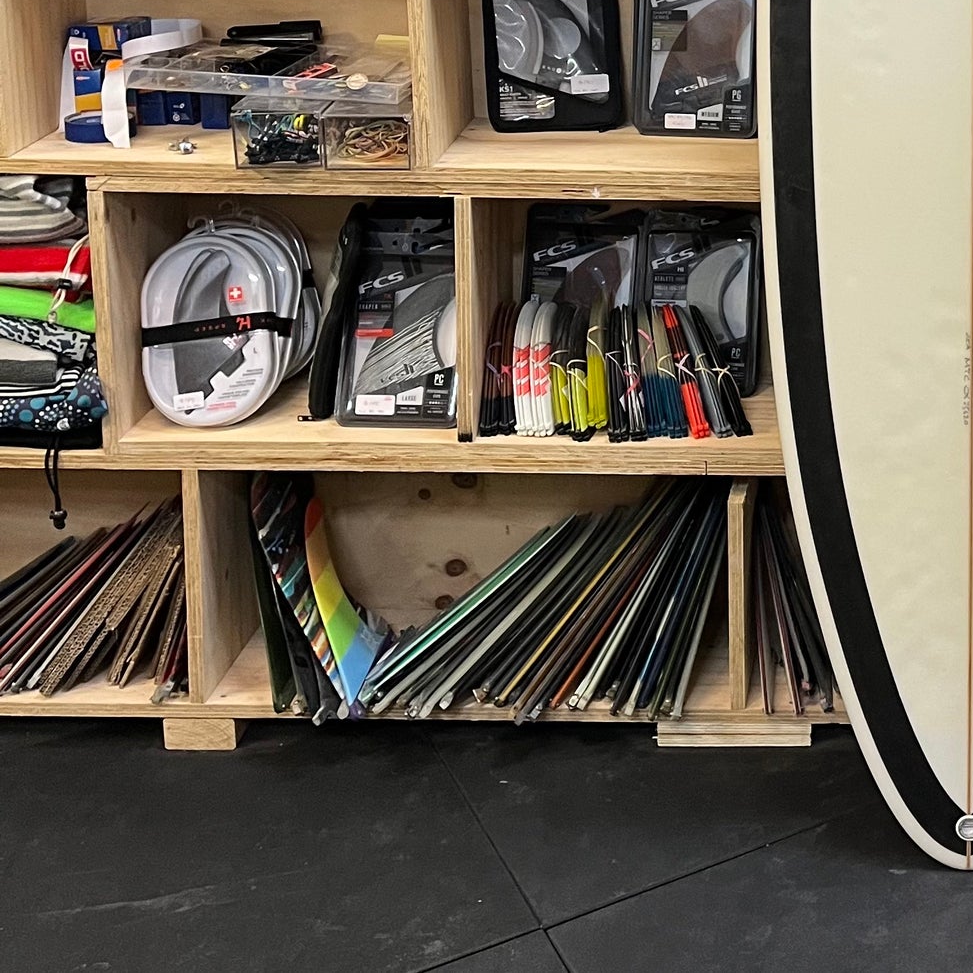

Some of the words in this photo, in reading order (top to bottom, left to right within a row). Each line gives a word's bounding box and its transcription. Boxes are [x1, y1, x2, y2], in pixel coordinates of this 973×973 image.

[533, 240, 577, 262] FCS
[651, 247, 695, 270] FCS
[359, 271, 404, 294] FCS
